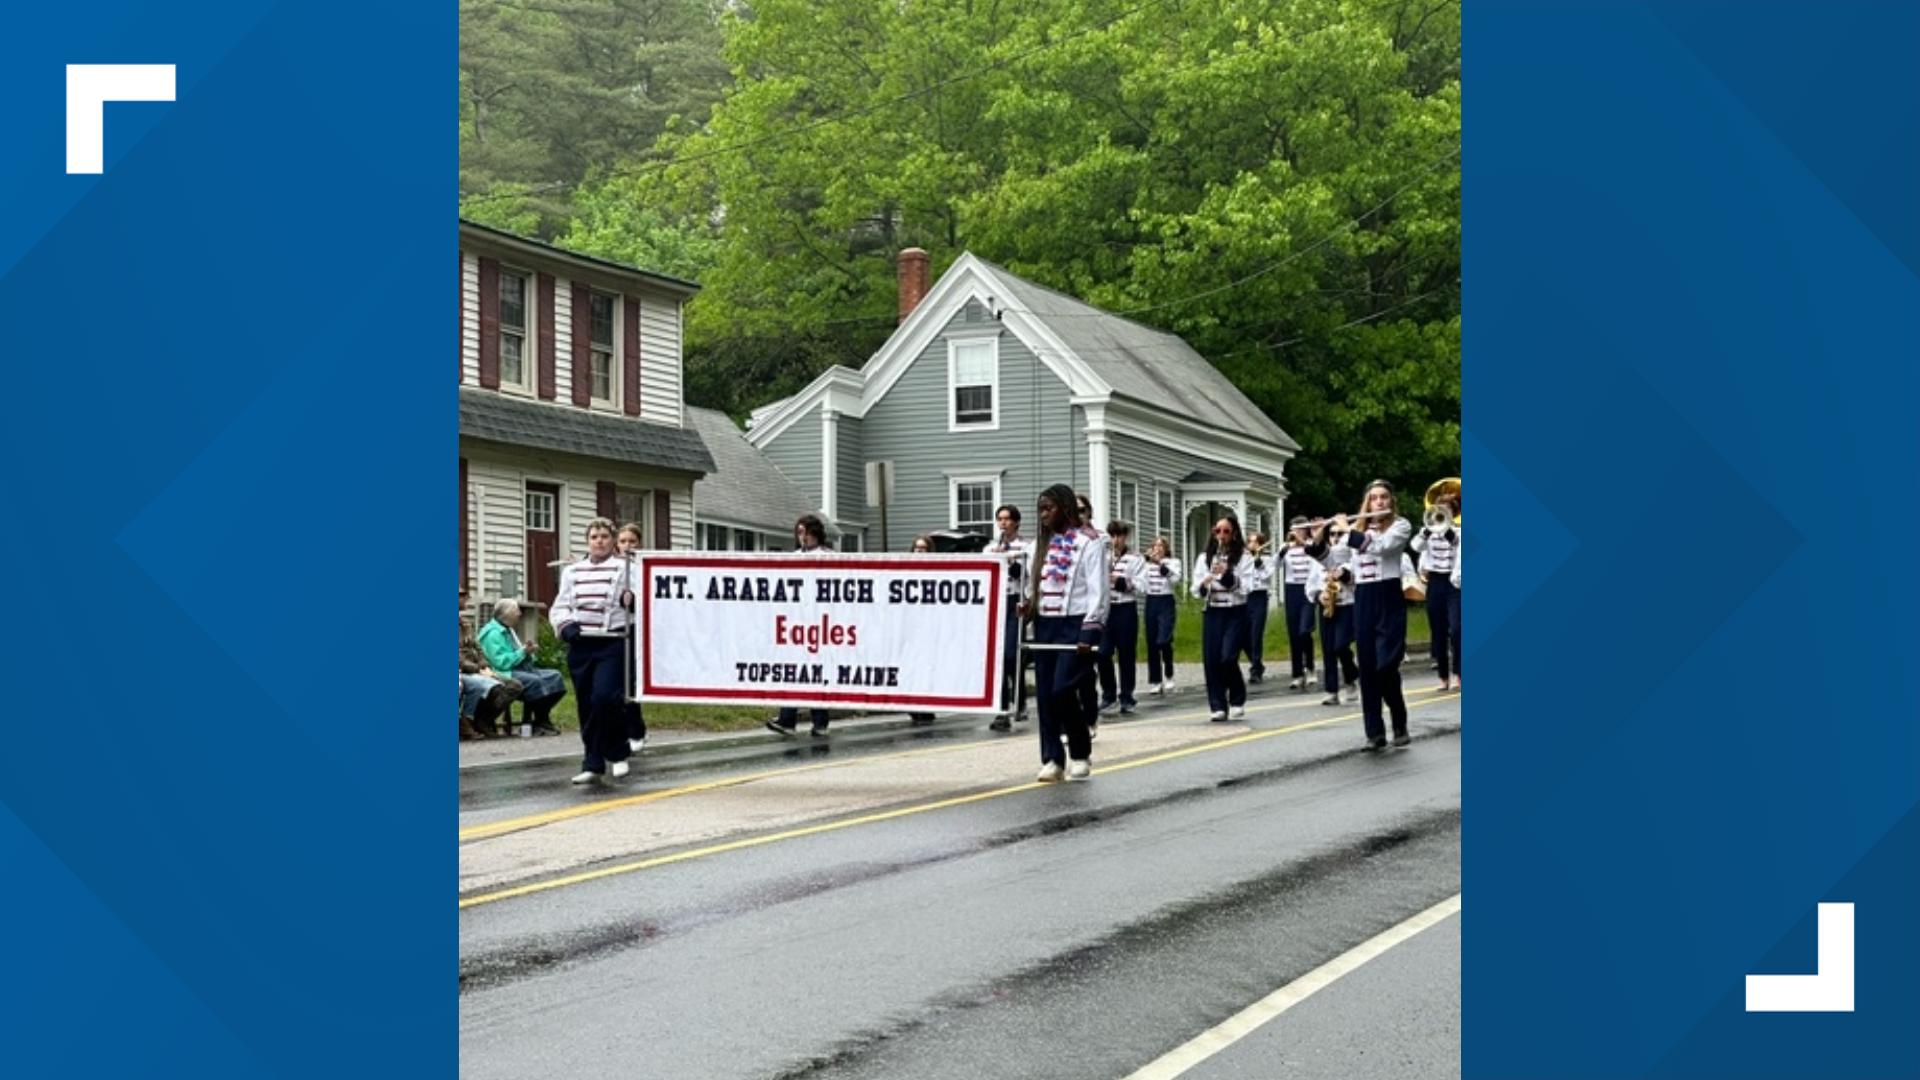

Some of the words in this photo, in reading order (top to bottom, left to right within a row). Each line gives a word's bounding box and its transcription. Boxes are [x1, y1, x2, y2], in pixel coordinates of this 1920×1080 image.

[654, 575, 693, 600] MT.
[705, 576, 803, 603] ARARAT
[815, 578, 875, 603] HIGH
[888, 579, 985, 605] SCHOOL
[775, 614, 857, 654] Eagles
[736, 662, 829, 686] TOPSHAM,
[837, 665, 899, 687] MAINE
